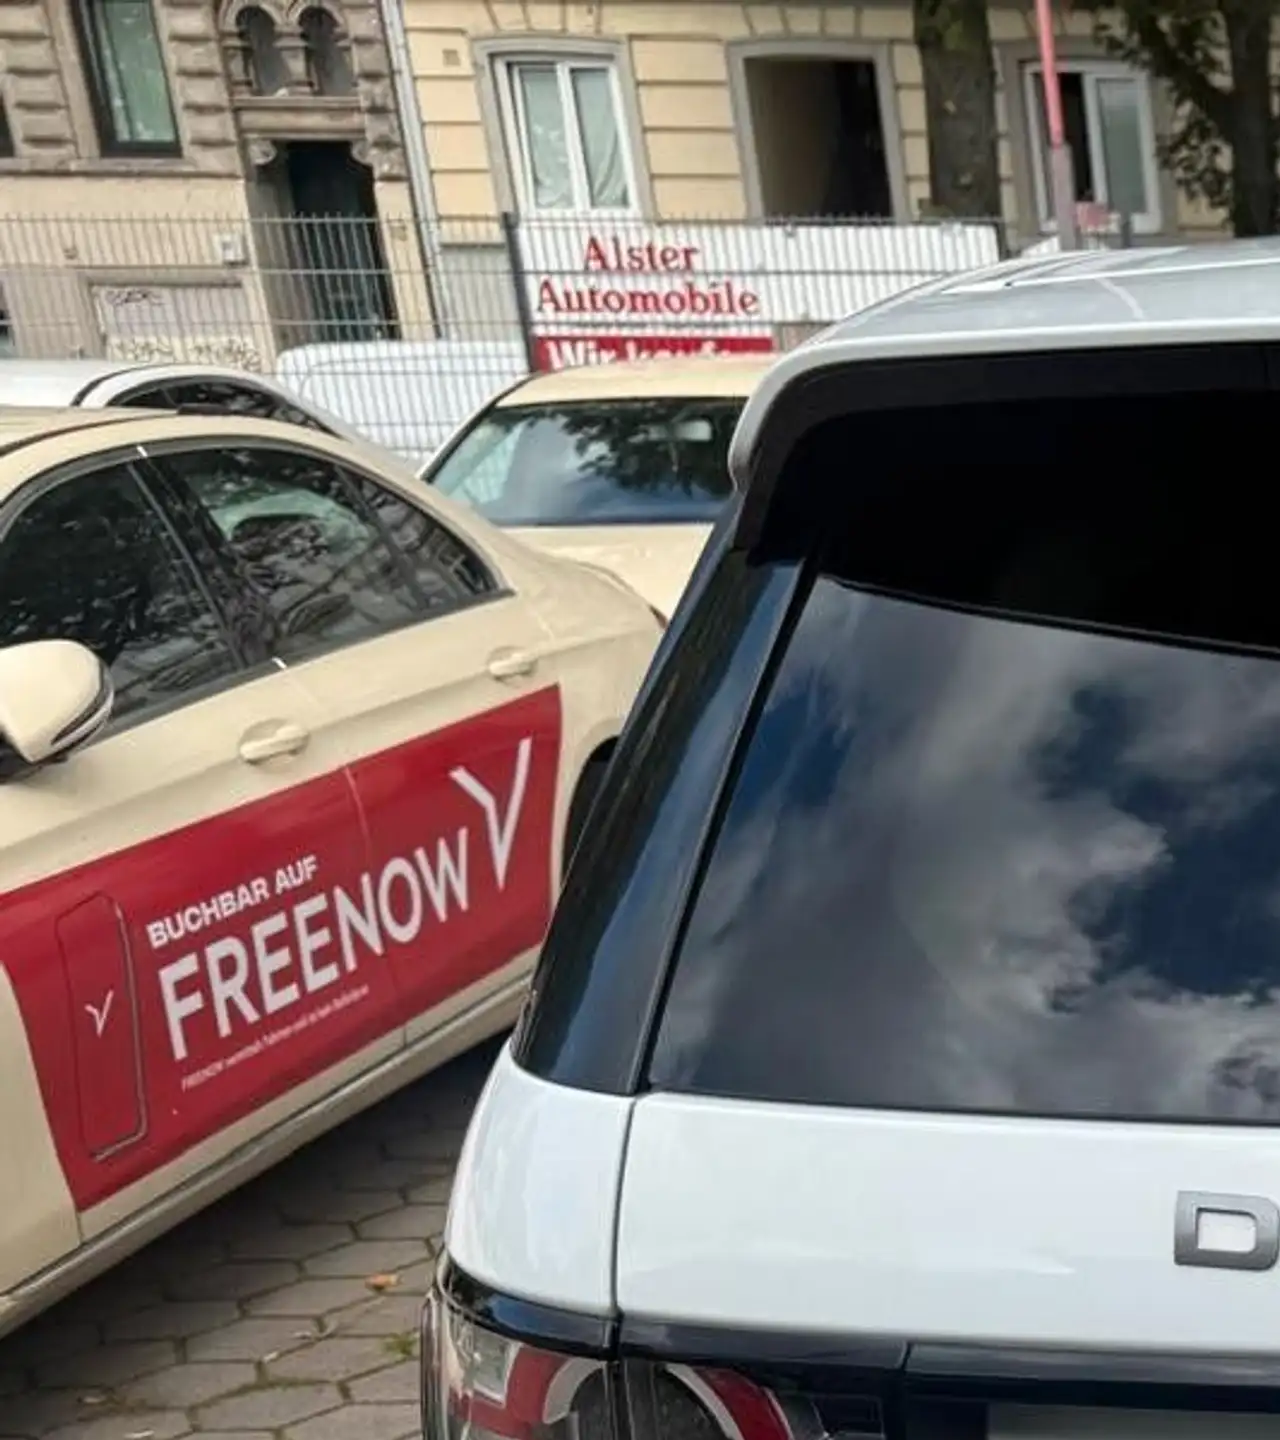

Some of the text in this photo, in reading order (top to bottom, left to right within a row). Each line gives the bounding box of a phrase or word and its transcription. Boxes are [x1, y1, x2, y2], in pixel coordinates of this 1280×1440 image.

[583, 235, 700, 273] Alster
[538, 278, 761, 315] Automobile
[146, 854, 319, 949] BUCHBAR AUF
[158, 826, 470, 1062] FREENOW
